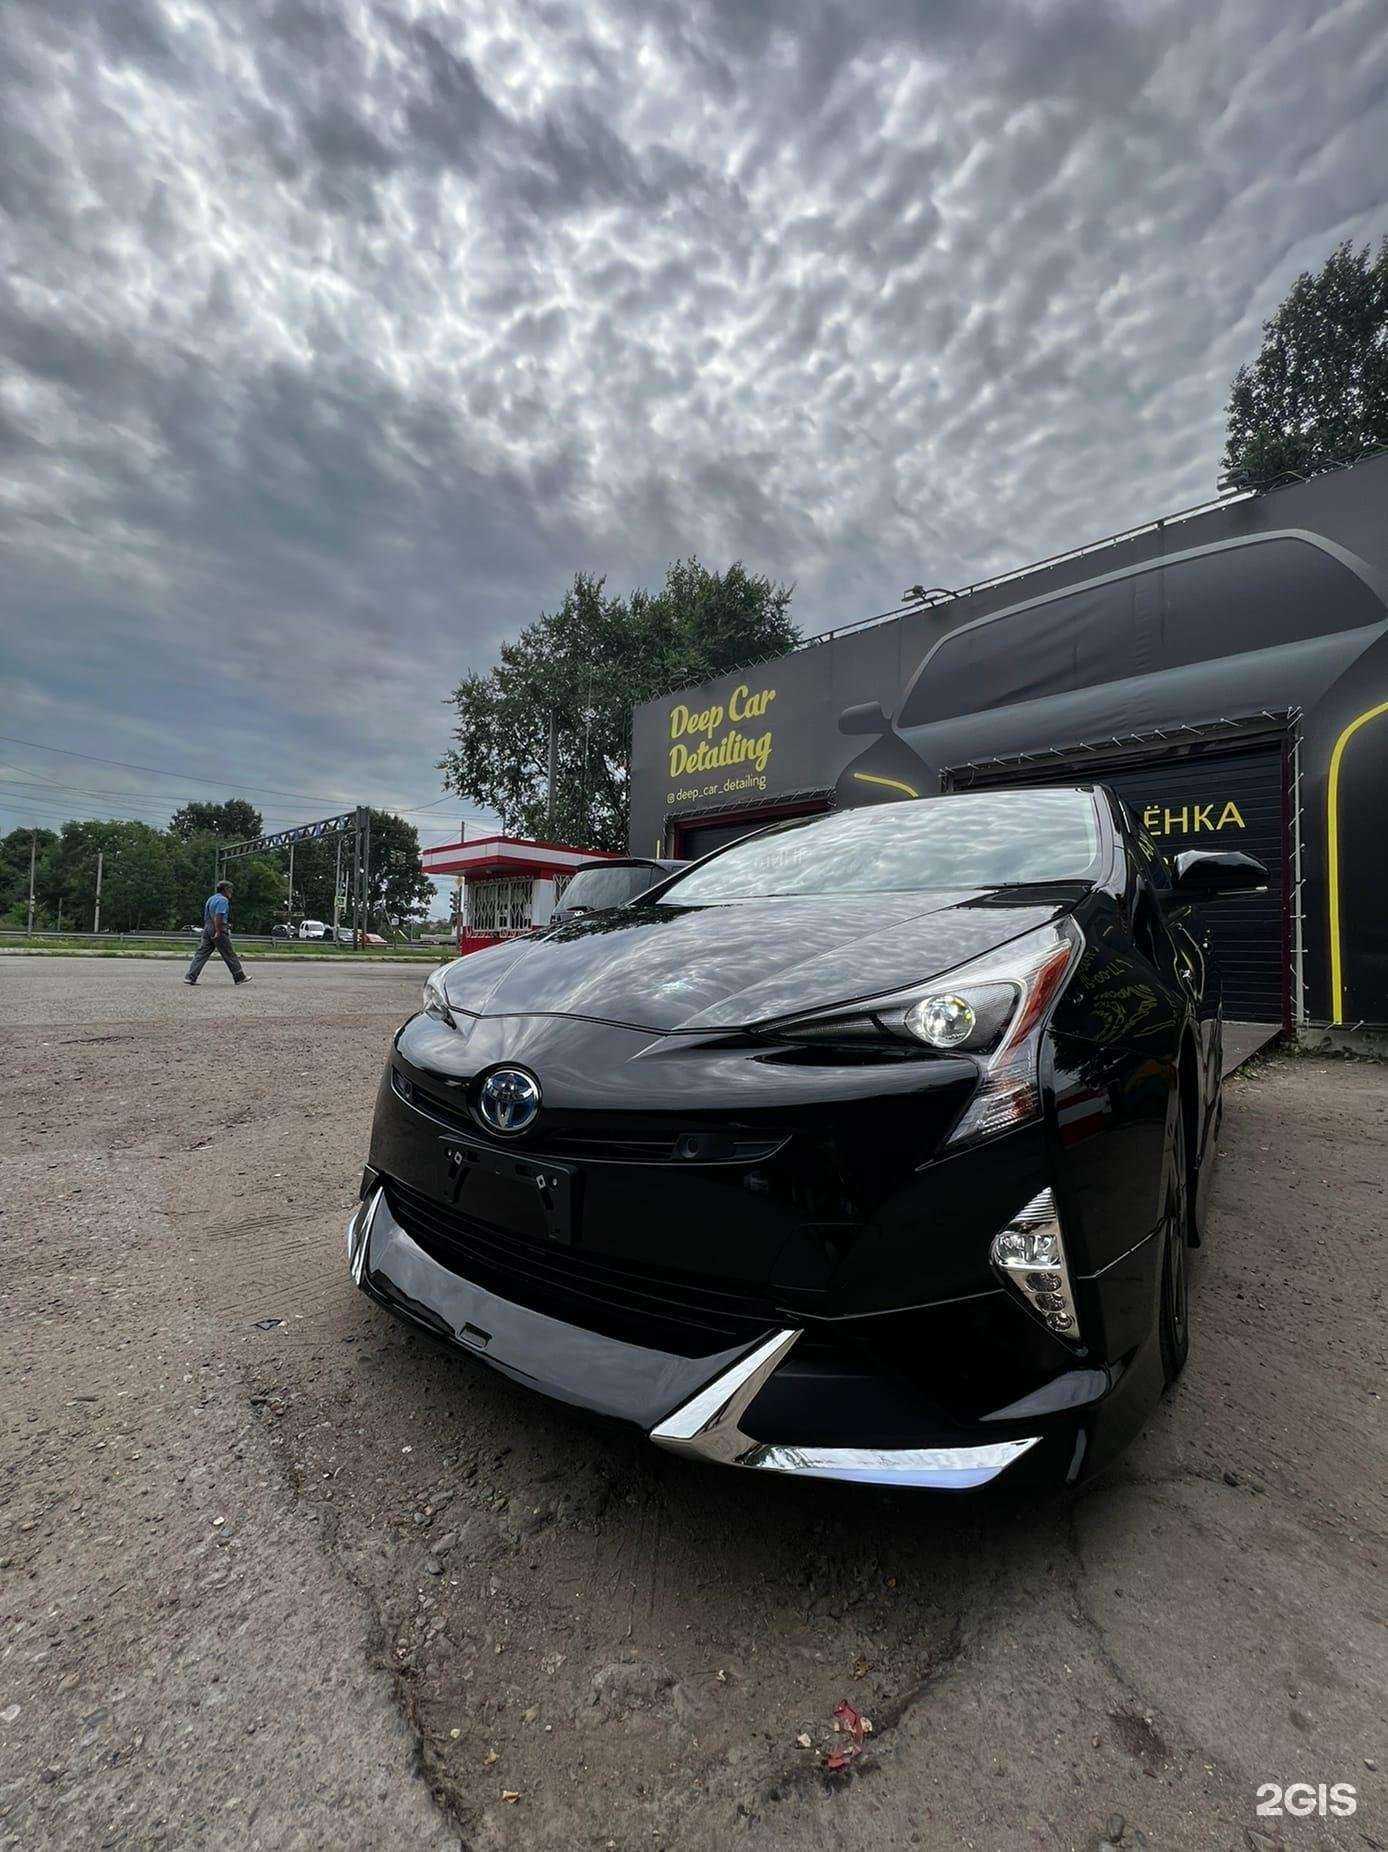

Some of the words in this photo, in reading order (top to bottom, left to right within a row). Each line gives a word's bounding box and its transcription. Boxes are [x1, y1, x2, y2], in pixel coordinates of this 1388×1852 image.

[670, 705, 724, 739] Deep
[729, 685, 776, 722] Car
[669, 730, 772, 778] Detailing
